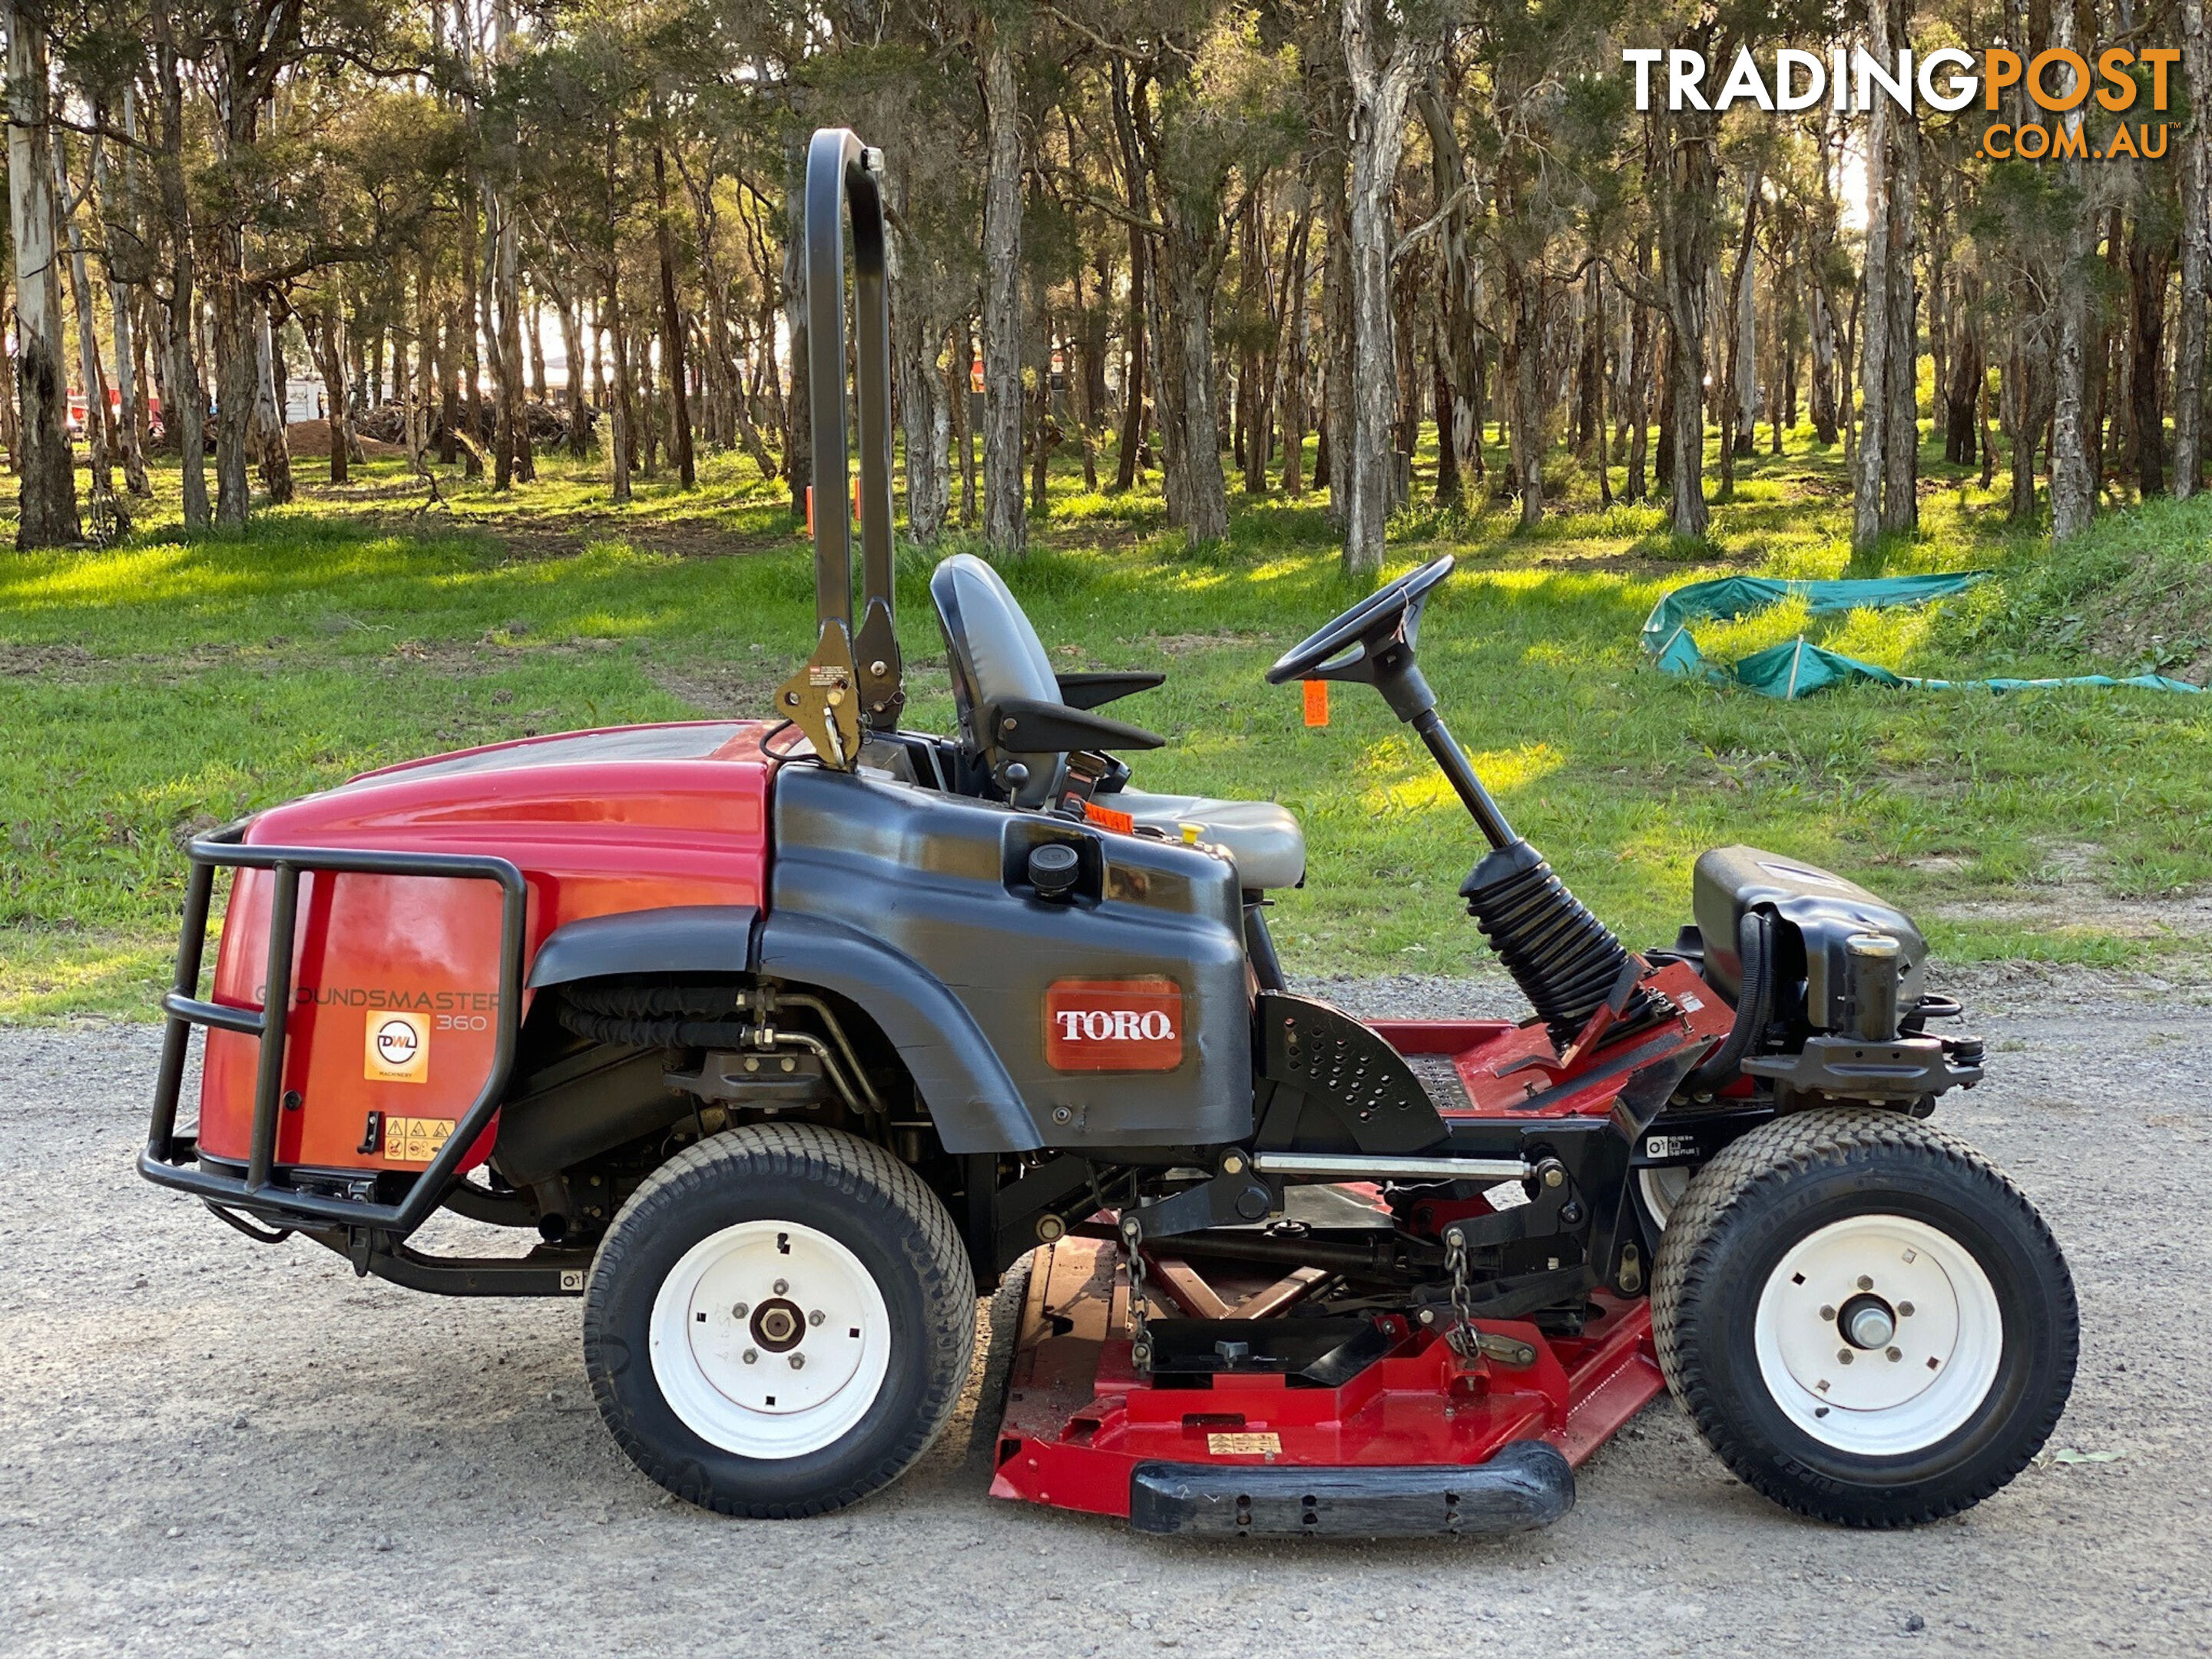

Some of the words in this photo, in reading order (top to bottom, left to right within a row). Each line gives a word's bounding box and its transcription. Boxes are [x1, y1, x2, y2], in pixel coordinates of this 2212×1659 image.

[255, 985, 500, 1012] GOUNDSMASTER
[436, 1015, 487, 1031] 360
[378, 1035, 417, 1048] DWL
